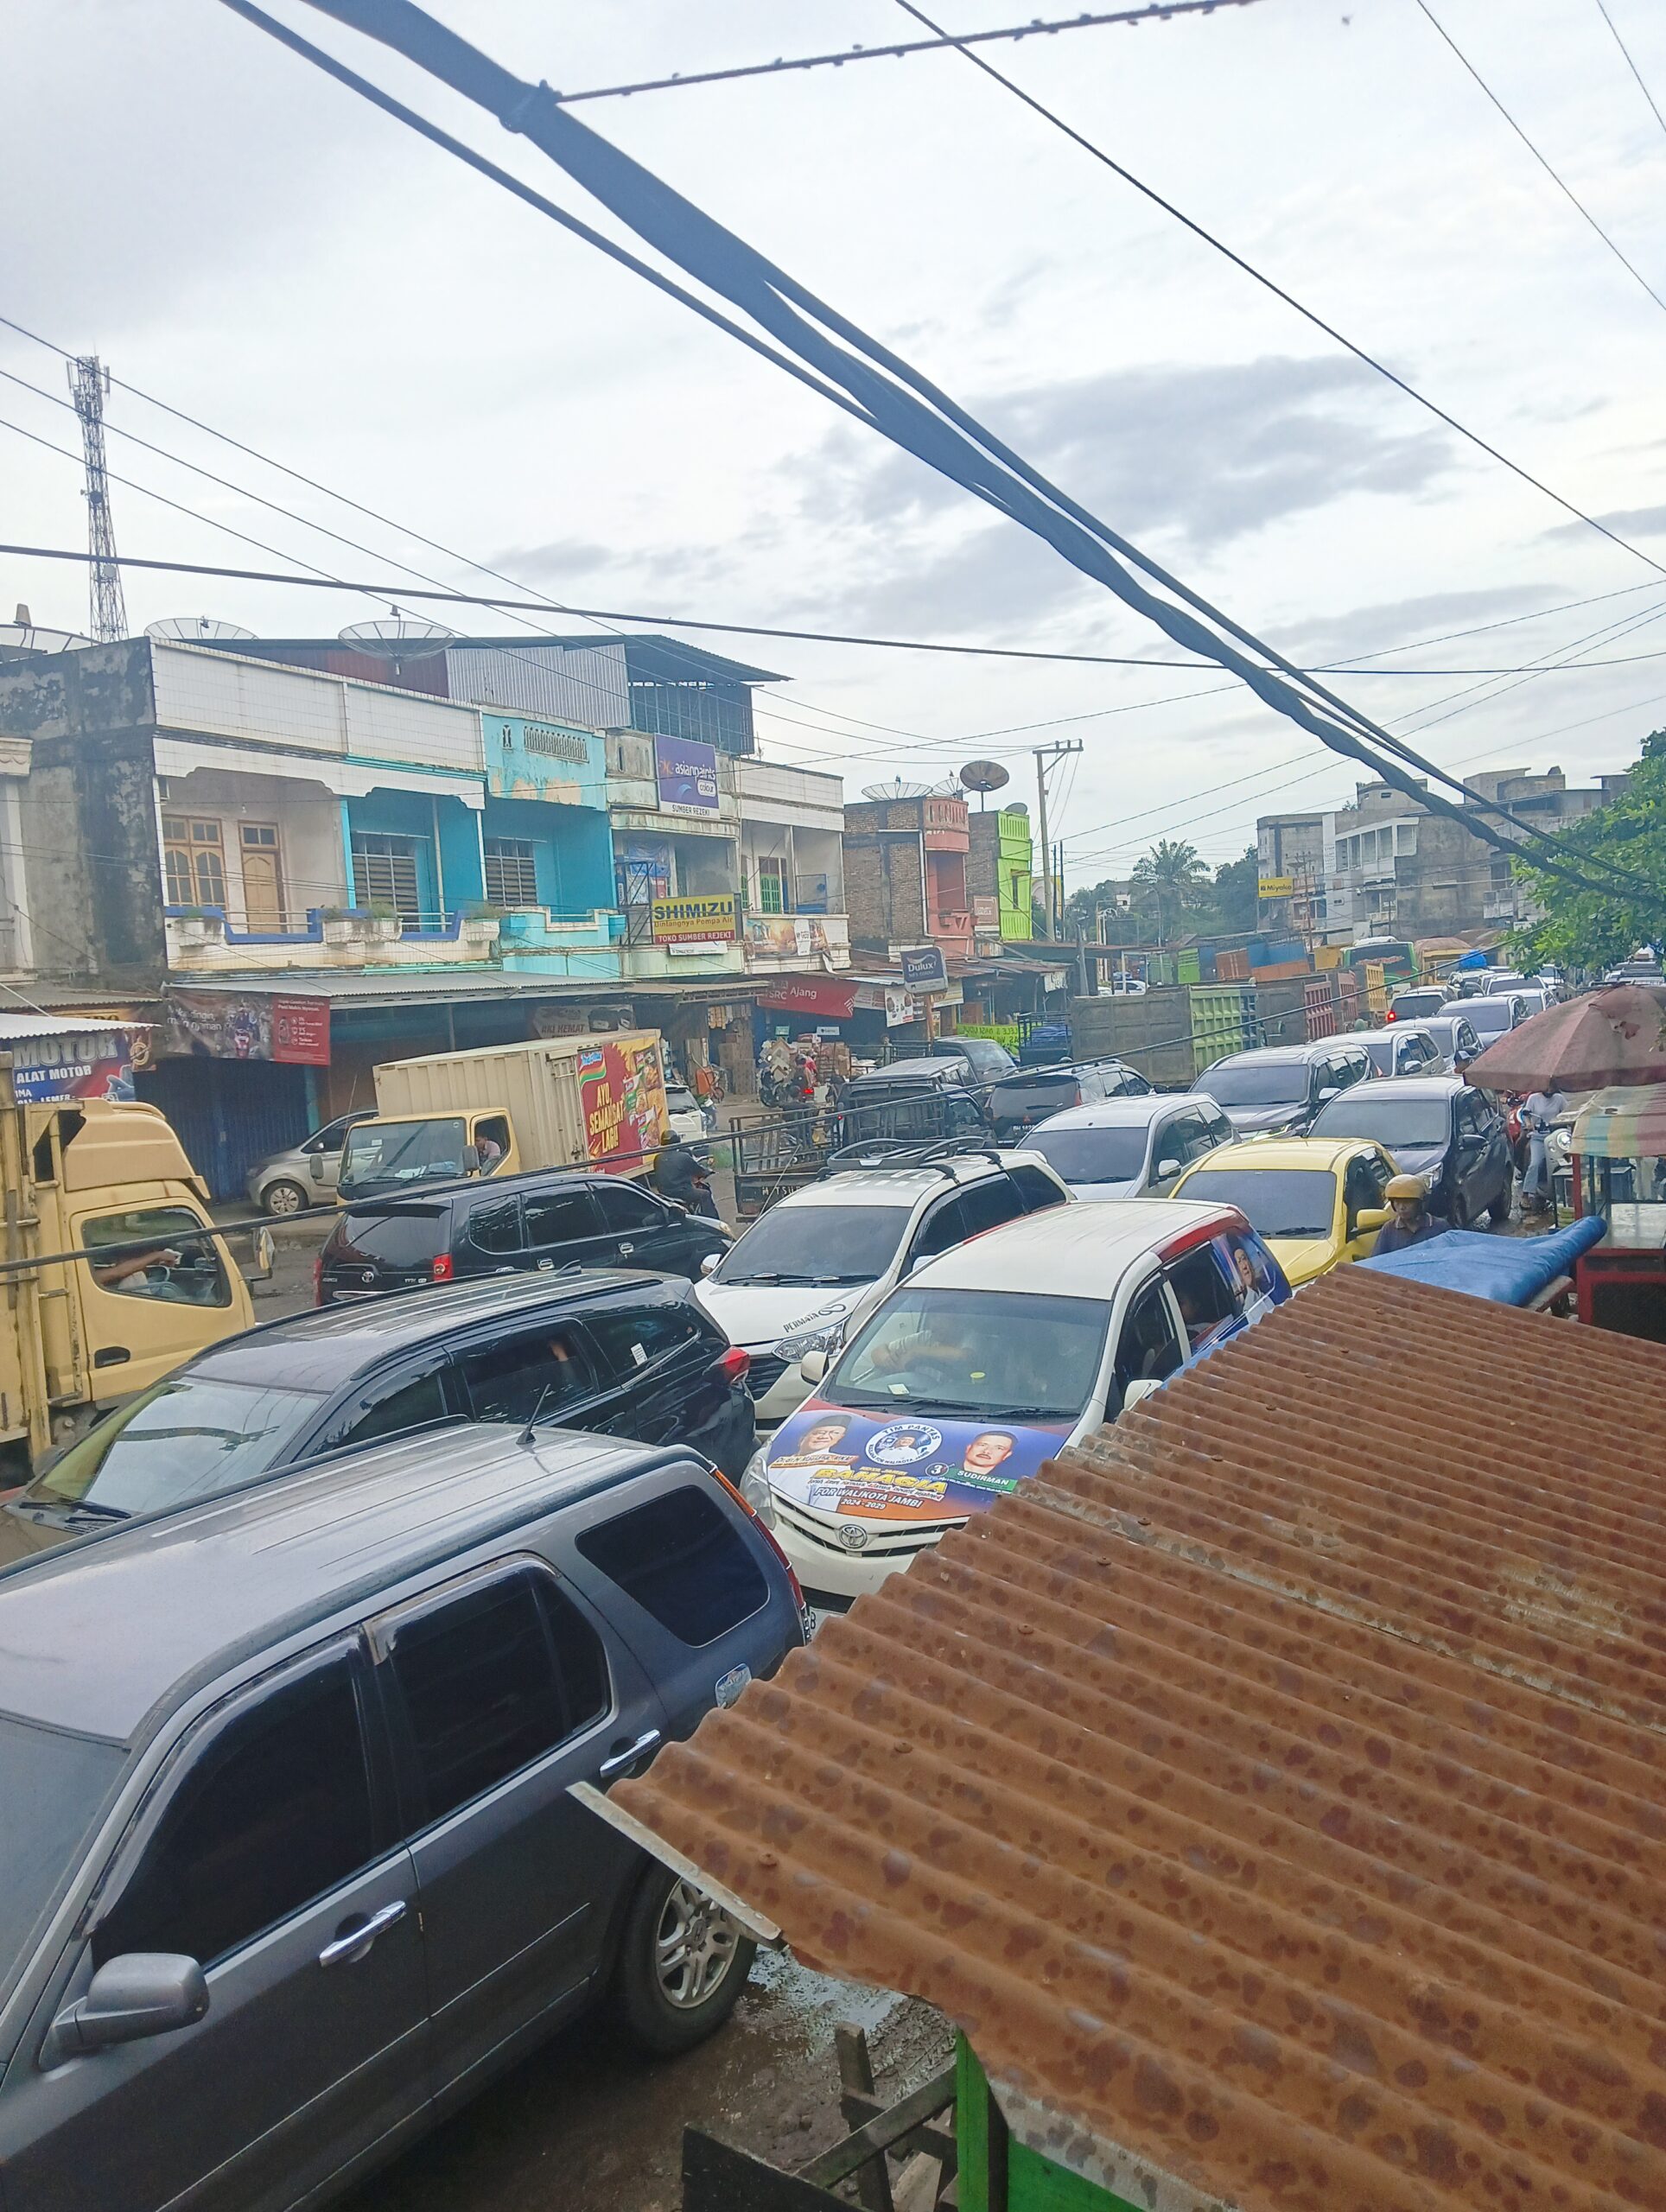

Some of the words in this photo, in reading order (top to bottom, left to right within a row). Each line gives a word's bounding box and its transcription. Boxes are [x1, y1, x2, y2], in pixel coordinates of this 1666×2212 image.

[672, 804, 691, 813] SUMBER
[654, 901, 733, 920] SHIMIZU
[907, 963, 933, 972] Dulux
[768, 990, 787, 1000] SRC
[790, 987, 817, 1000] Ajang
[13, 1033, 118, 1068] MOTOR
[16, 1071, 46, 1084] ALAT
[49, 1065, 92, 1080] MOTOR
[596, 1082, 613, 1108] AYO,
[589, 1100, 624, 1137] SEMANGAT
[601, 1125, 619, 1154] LAGI!
[783, 1313, 819, 1333] PERMATA
[882, 1426, 903, 1434] TIM
[908, 1425, 940, 1440] PANTAS
[932, 1465, 943, 1474] 3
[957, 1471, 1009, 1485] SUDIRMAN
[812, 1468, 948, 1494] BAHAGIA
[814, 1487, 836, 1497] FOR
[837, 1488, 888, 1502] WALIKOTA
[888, 1496, 924, 1508] JAMBI
